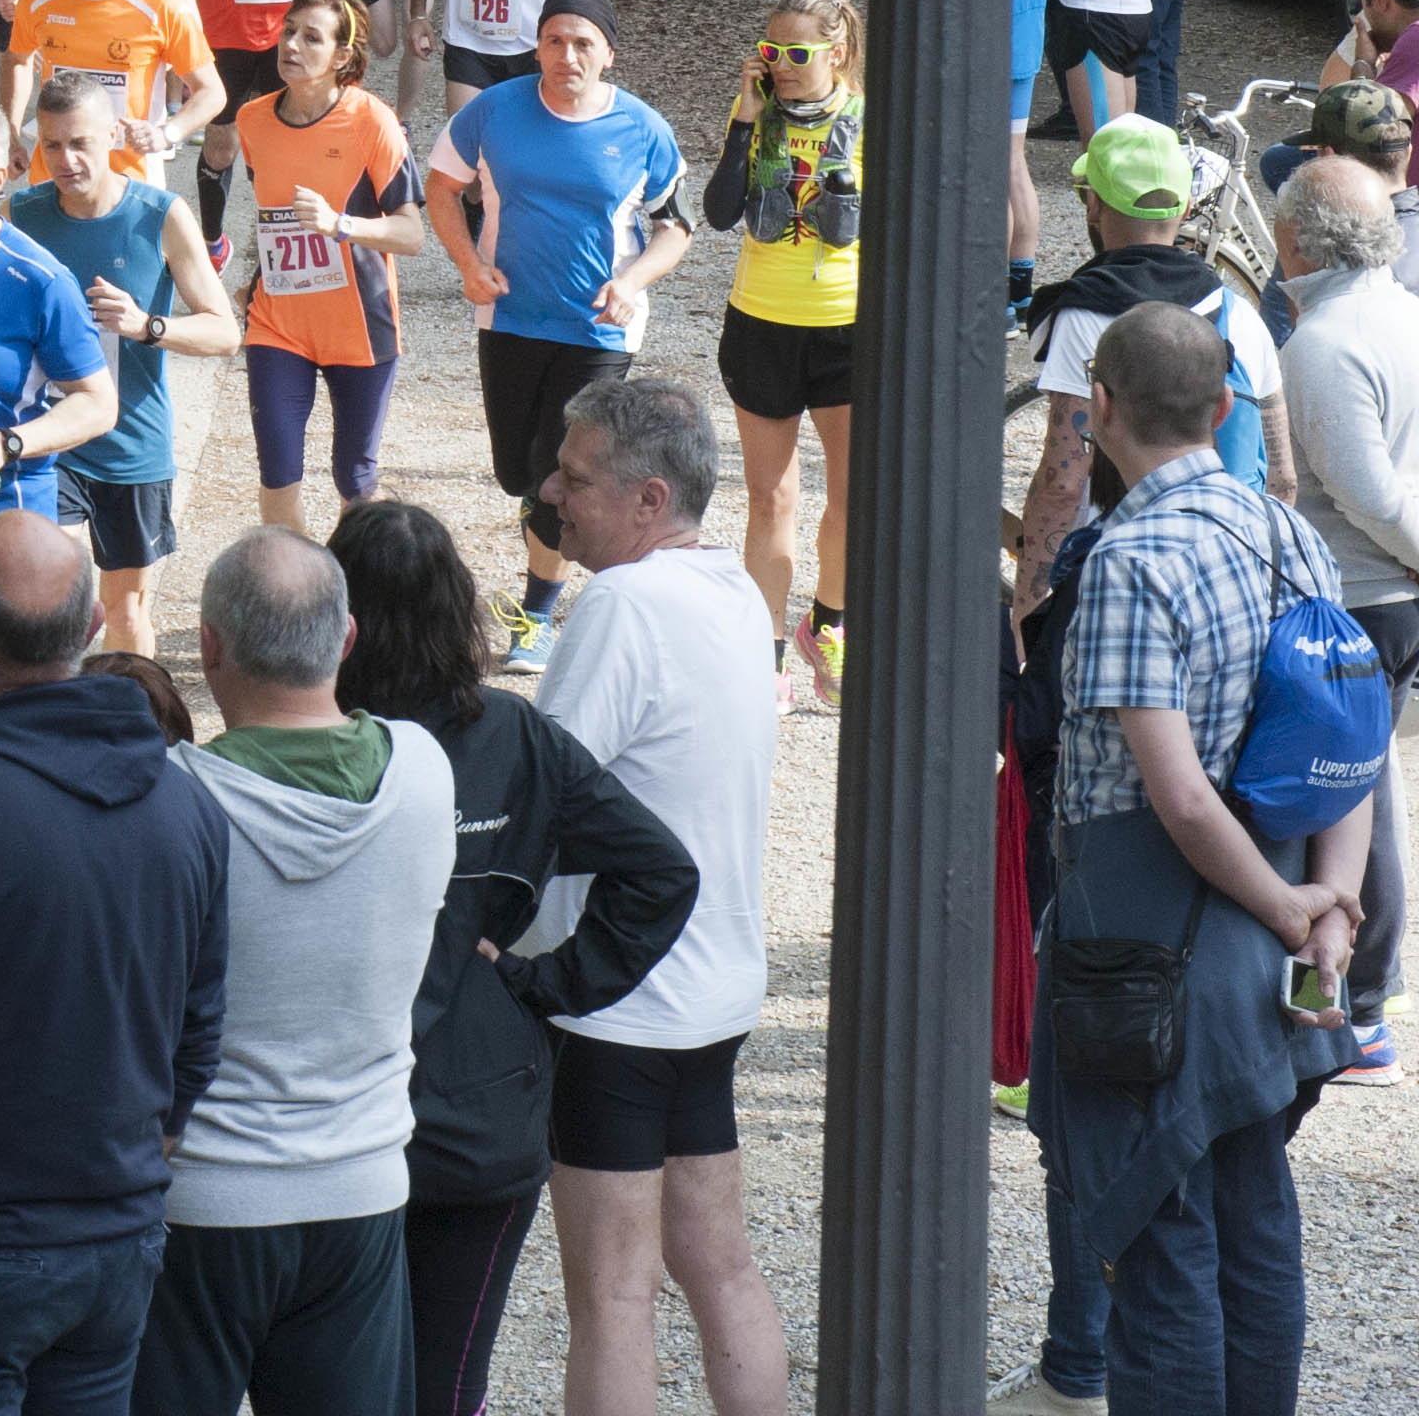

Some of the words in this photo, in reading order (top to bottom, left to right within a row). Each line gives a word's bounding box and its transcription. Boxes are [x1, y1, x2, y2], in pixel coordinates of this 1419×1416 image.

[267, 250, 274, 271] F
[276, 233, 331, 272] 270
[1310, 756, 1352, 778] LUPPI
